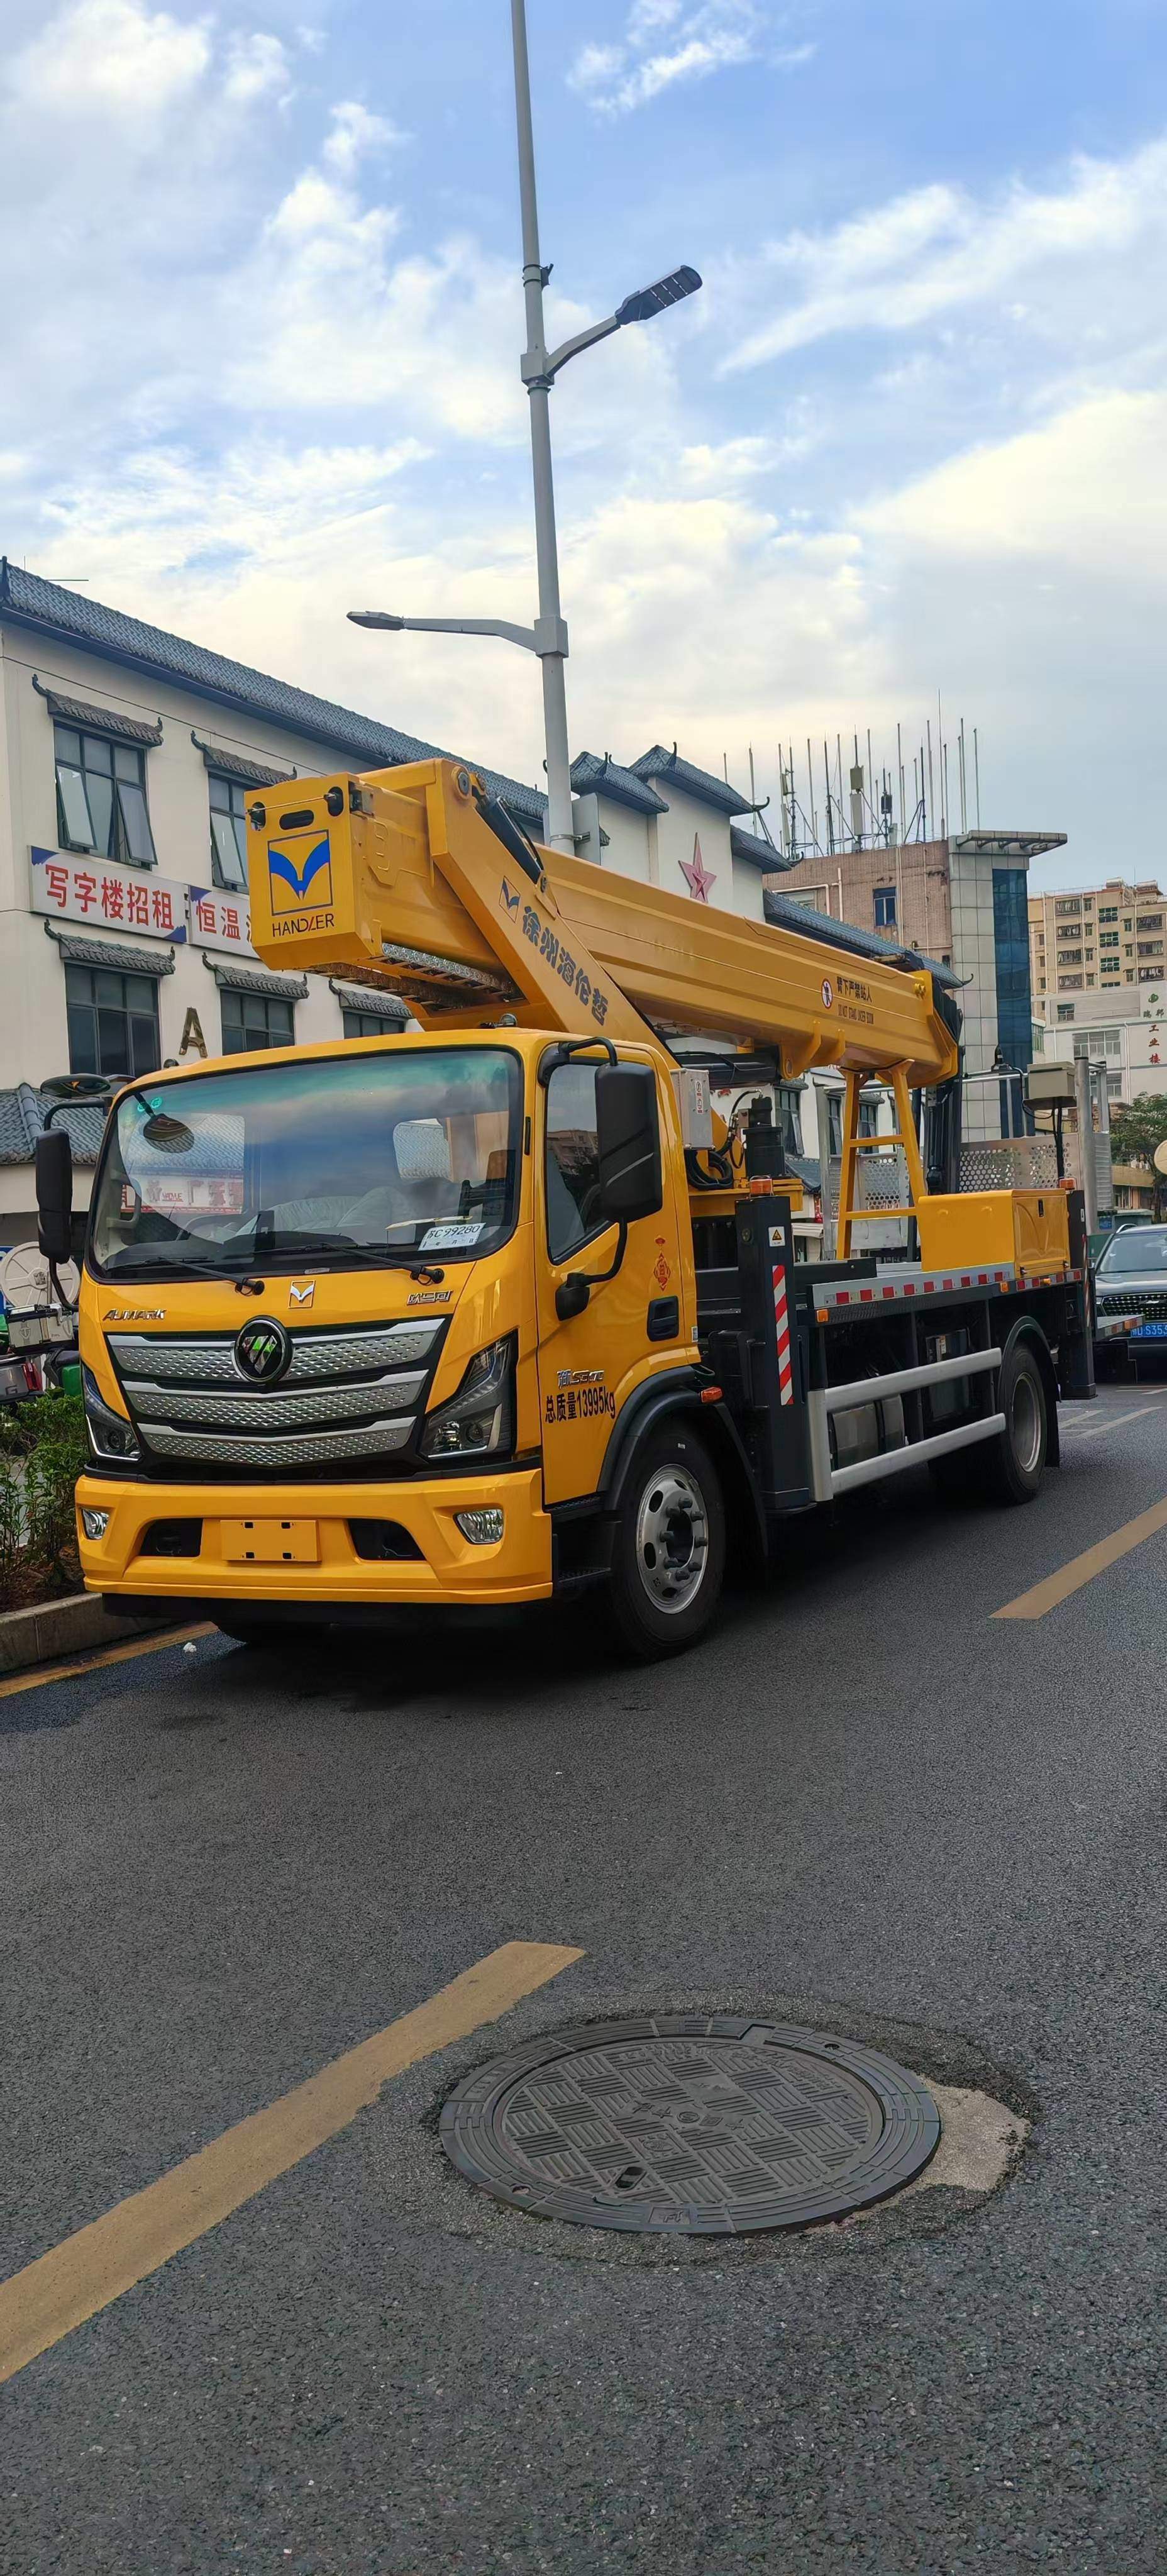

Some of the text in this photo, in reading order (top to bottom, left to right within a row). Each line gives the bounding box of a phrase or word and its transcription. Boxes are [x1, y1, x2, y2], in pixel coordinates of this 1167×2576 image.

[45, 863, 175, 931] 写字楼招租
[196, 899, 251, 942] 恒温
[522, 906, 609, 1026] 徐州海伦哲
[179, 1008, 208, 1058] A
[1149, 1024, 1161, 1064] 工业楼
[545, 1385, 616, 1423] 总质量13995kg
